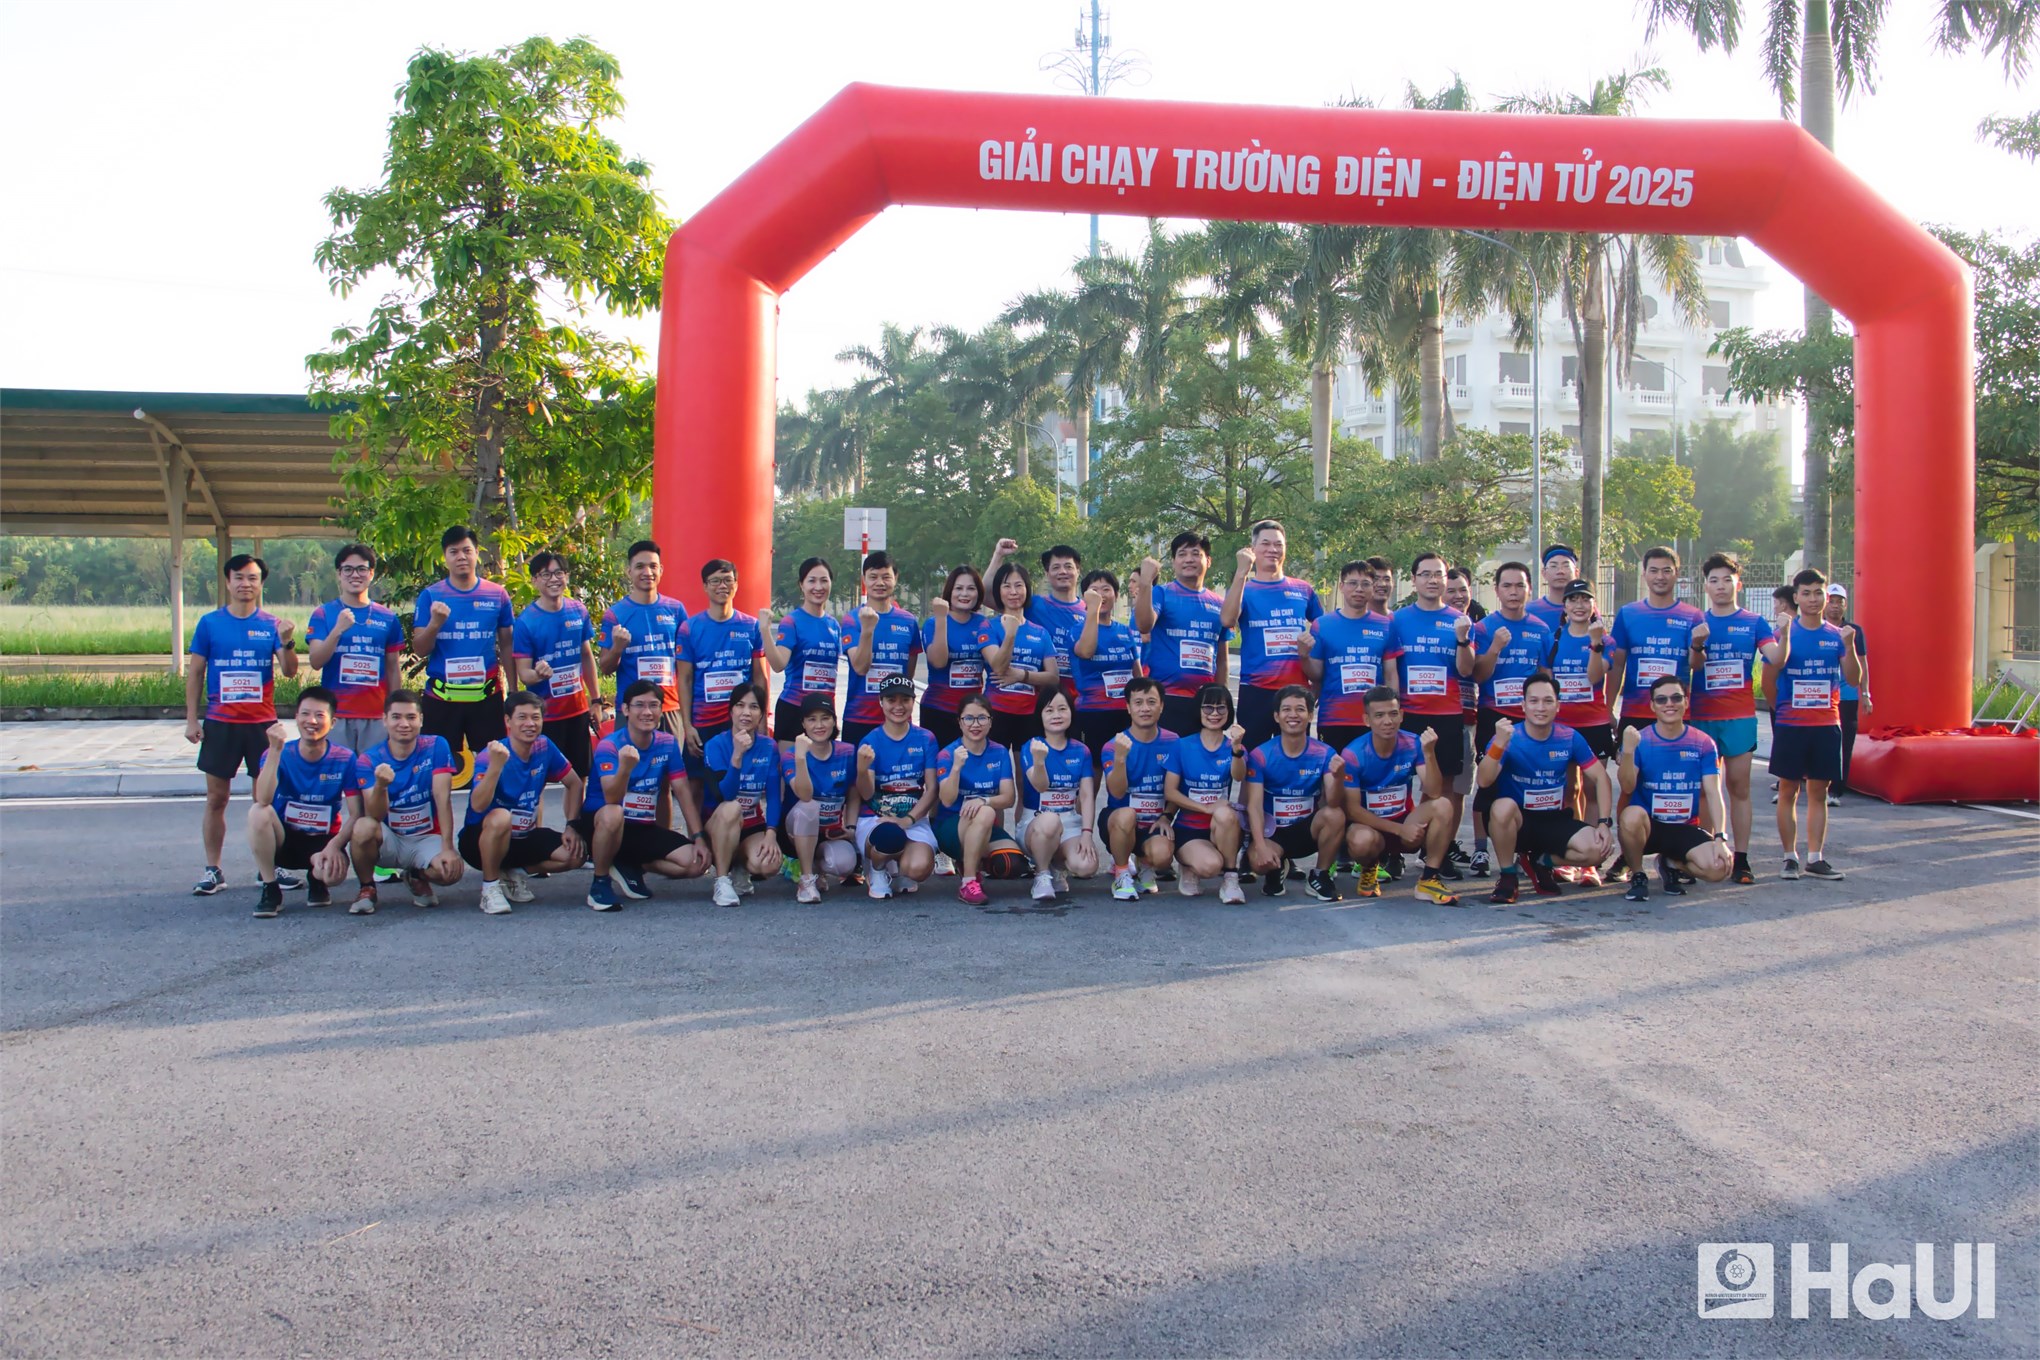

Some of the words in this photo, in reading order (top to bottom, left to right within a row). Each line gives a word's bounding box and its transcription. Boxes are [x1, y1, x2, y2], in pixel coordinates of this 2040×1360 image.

[980, 128, 1053, 182] GIẢI
[1062, 144, 1158, 194] CHẠY
[1173, 139, 1320, 195] TRƯỜNG
[1335, 148, 1421, 206] ĐIỆN
[1458, 152, 1543, 209] ĐIỆN
[1555, 147, 1603, 202] TỬ
[1606, 165, 1694, 208] 2025
[353, 662, 371, 670] 5025
[1378, 794, 1396, 802] 5026
[298, 811, 318, 820] 5037
[400, 813, 420, 821] 5007
